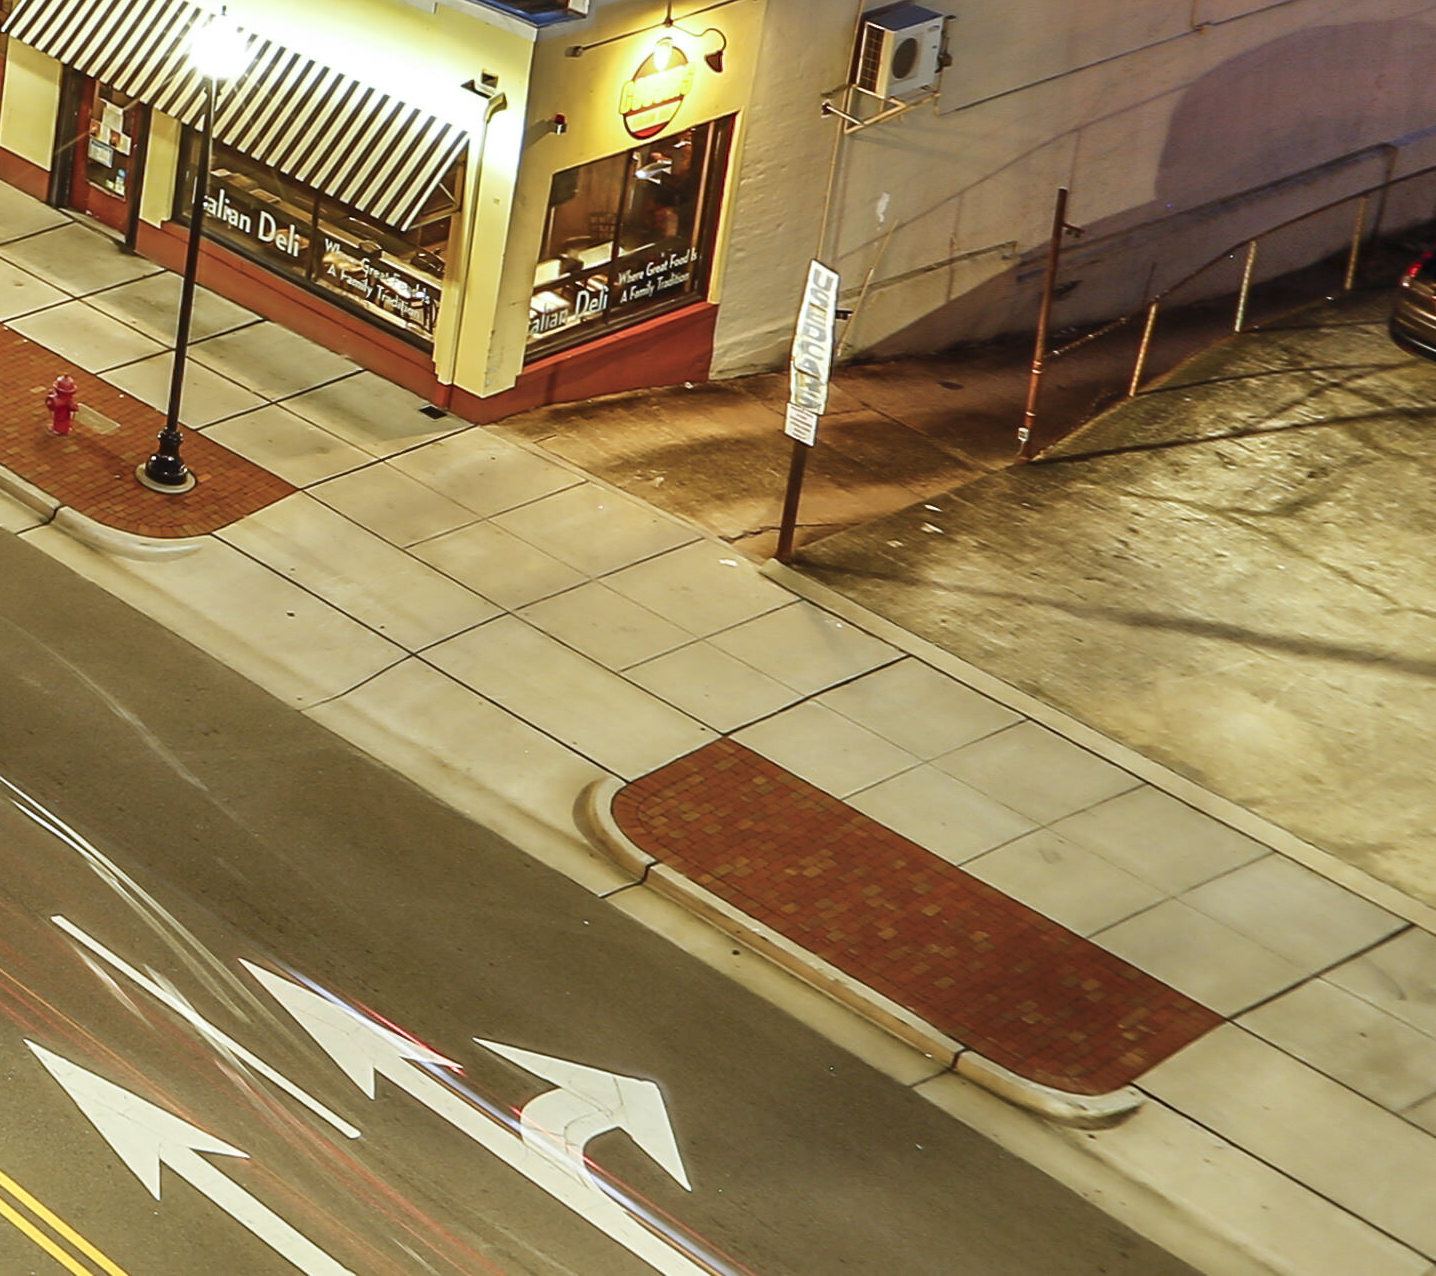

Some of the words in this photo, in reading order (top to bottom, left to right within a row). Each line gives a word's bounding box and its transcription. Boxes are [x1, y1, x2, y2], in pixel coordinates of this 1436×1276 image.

[192, 176, 251, 233] Ialian
[258, 210, 299, 257] Deli
[326, 265, 337, 277] A
[340, 268, 373, 297] Family
[618, 269, 644, 285] Where
[646, 261, 668, 278] Great
[669, 250, 690, 269] Food
[575, 285, 609, 321] Deli
[620, 289, 628, 304] A
[629, 280, 655, 300] Family
[657, 272, 691, 291] Tradition
